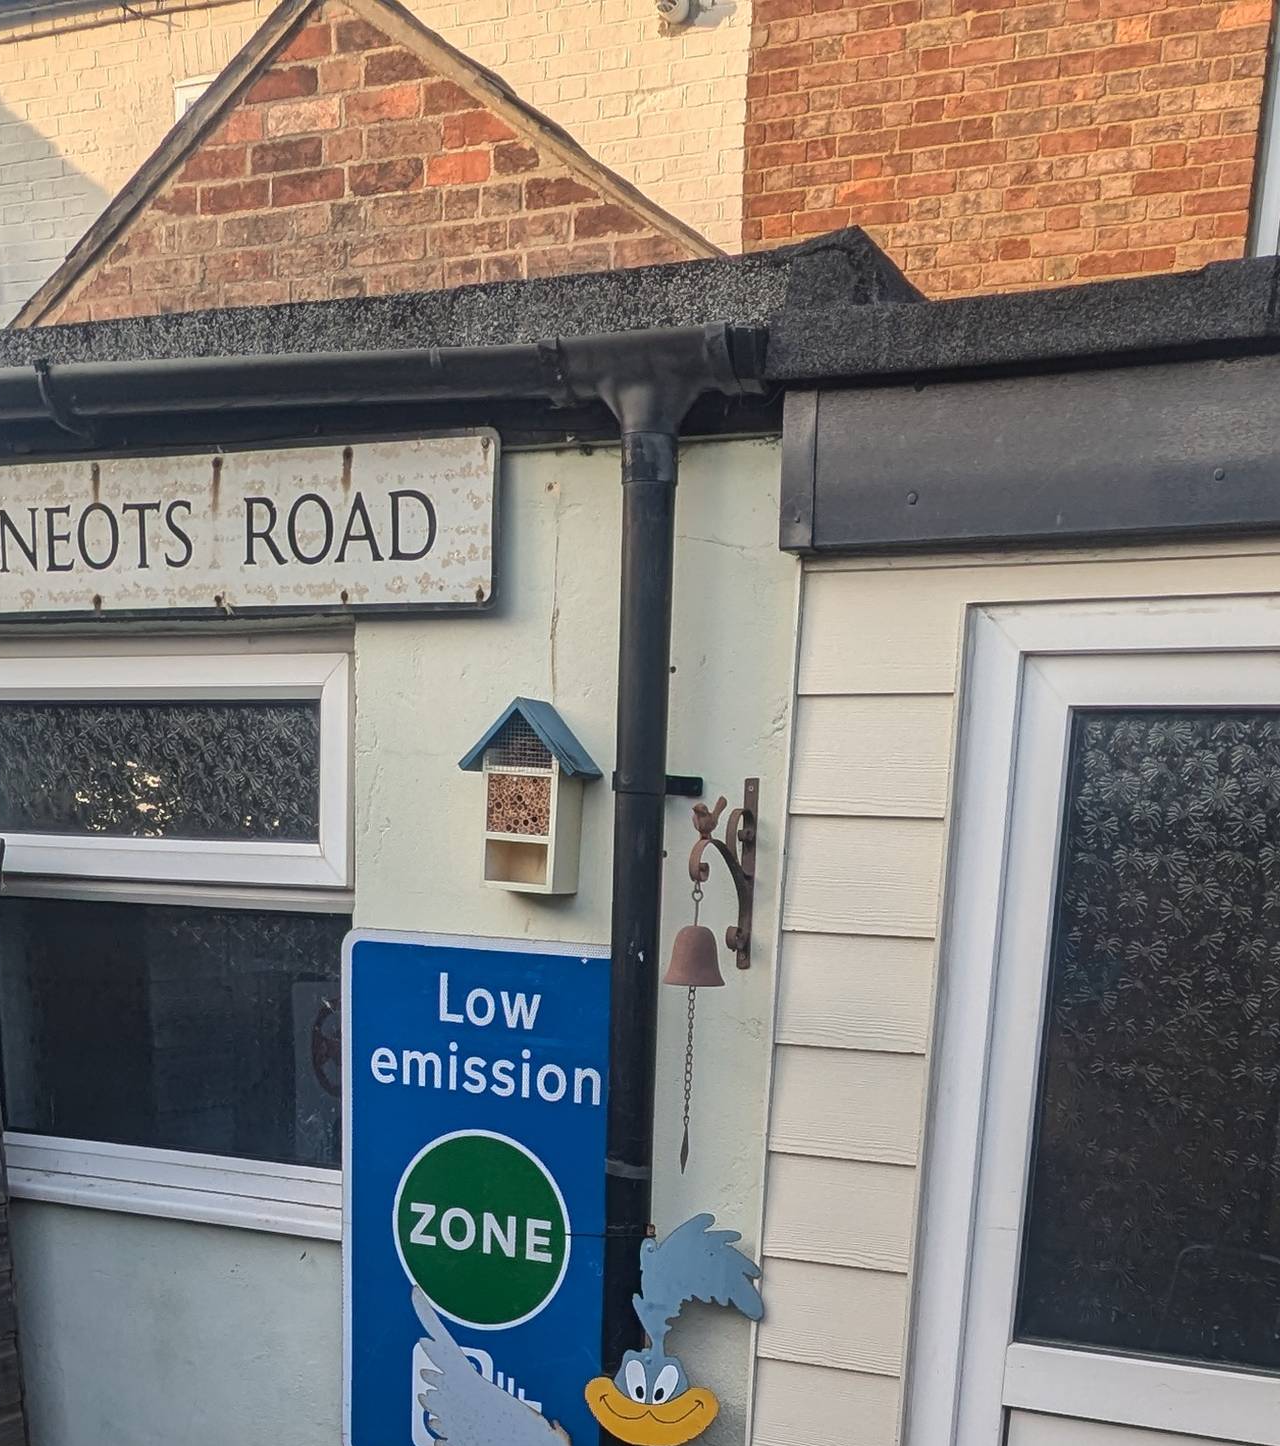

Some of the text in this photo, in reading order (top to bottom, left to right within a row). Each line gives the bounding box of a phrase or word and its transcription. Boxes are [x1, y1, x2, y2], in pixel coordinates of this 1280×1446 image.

[243, 488, 439, 566] ROAD
[438, 971, 542, 1031] Low
[370, 1041, 603, 1106] emission
[409, 1202, 553, 1263] ZONE
